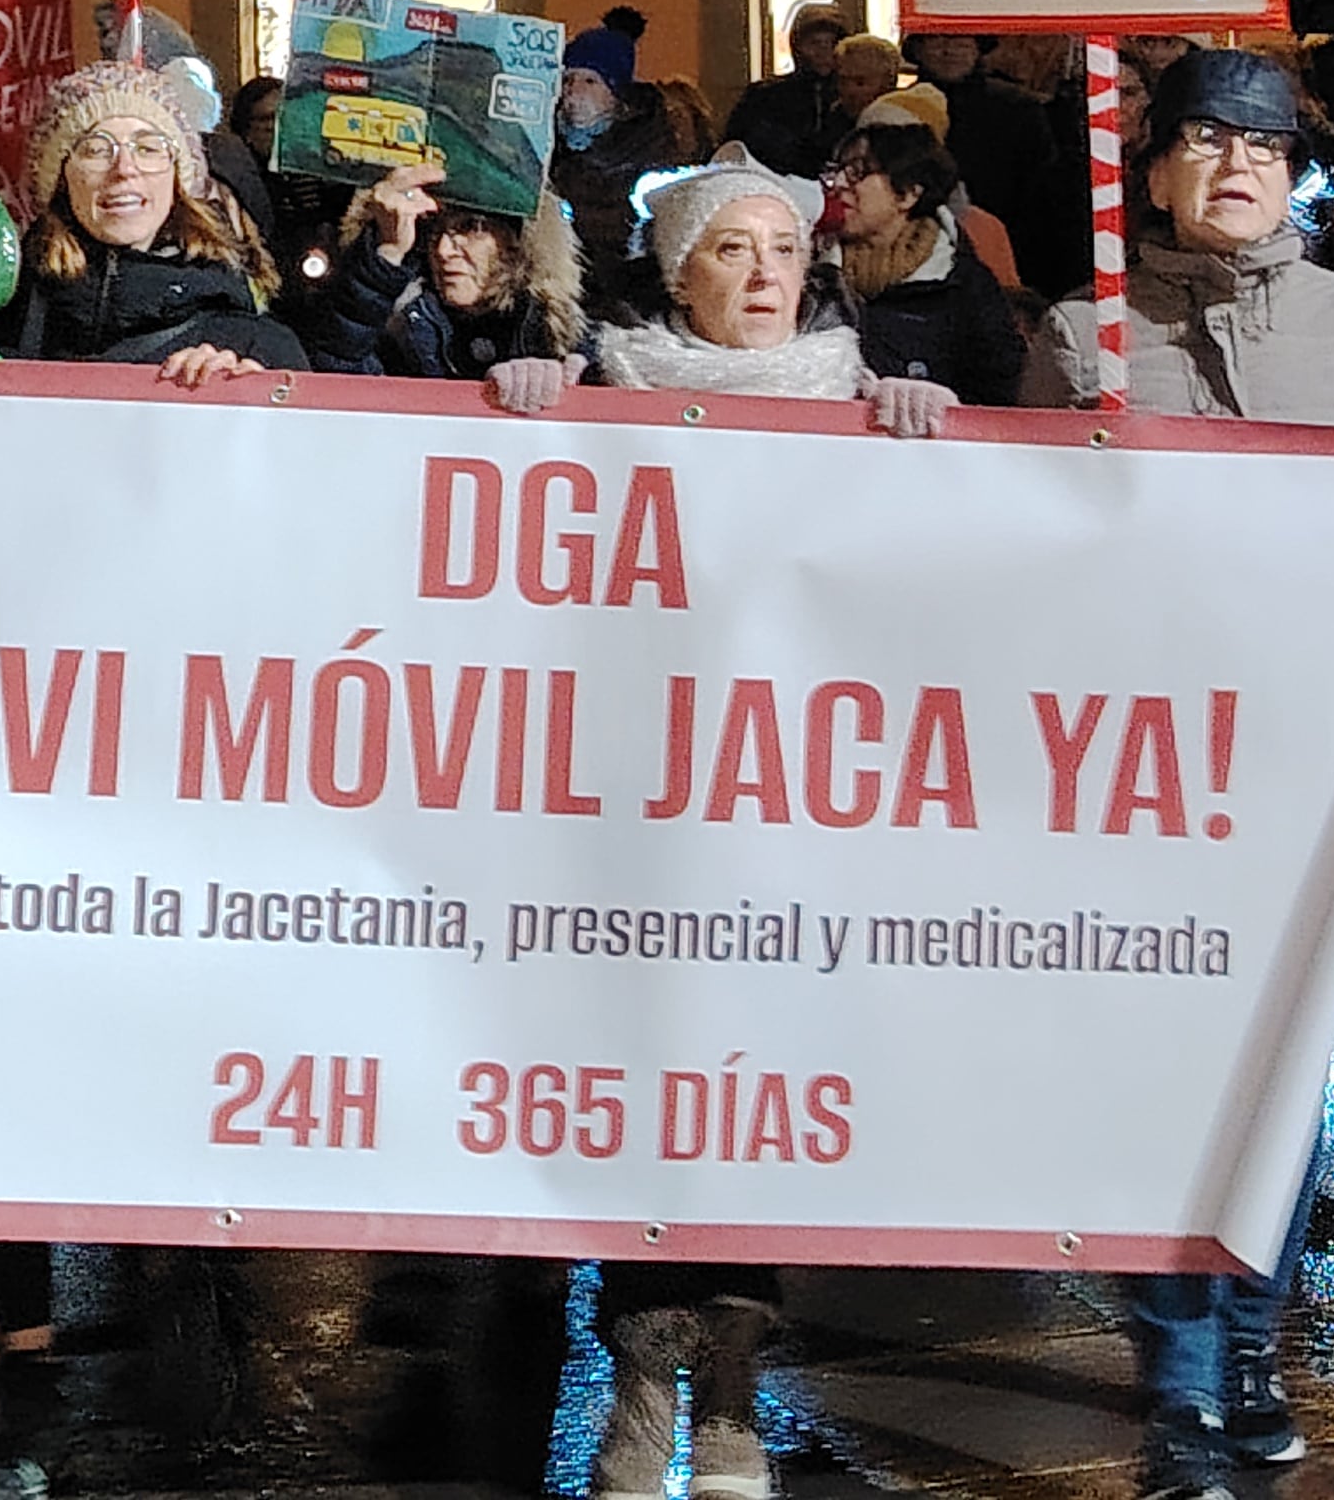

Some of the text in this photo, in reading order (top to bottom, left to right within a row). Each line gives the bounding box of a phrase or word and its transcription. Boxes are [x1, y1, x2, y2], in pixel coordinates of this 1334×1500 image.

[417, 455, 690, 610] DGA
[175, 627, 602, 818] MÓVIL
[641, 675, 979, 831] JACA
[1028, 688, 1240, 842] YA!
[131, 875, 183, 938] la
[198, 881, 485, 964] Jacetania,
[506, 898, 803, 964] presencial
[816, 914, 852, 974] y
[865, 905, 1232, 978] medicalizada
[208, 1050, 855, 1165] 24H 365 DÍAS
